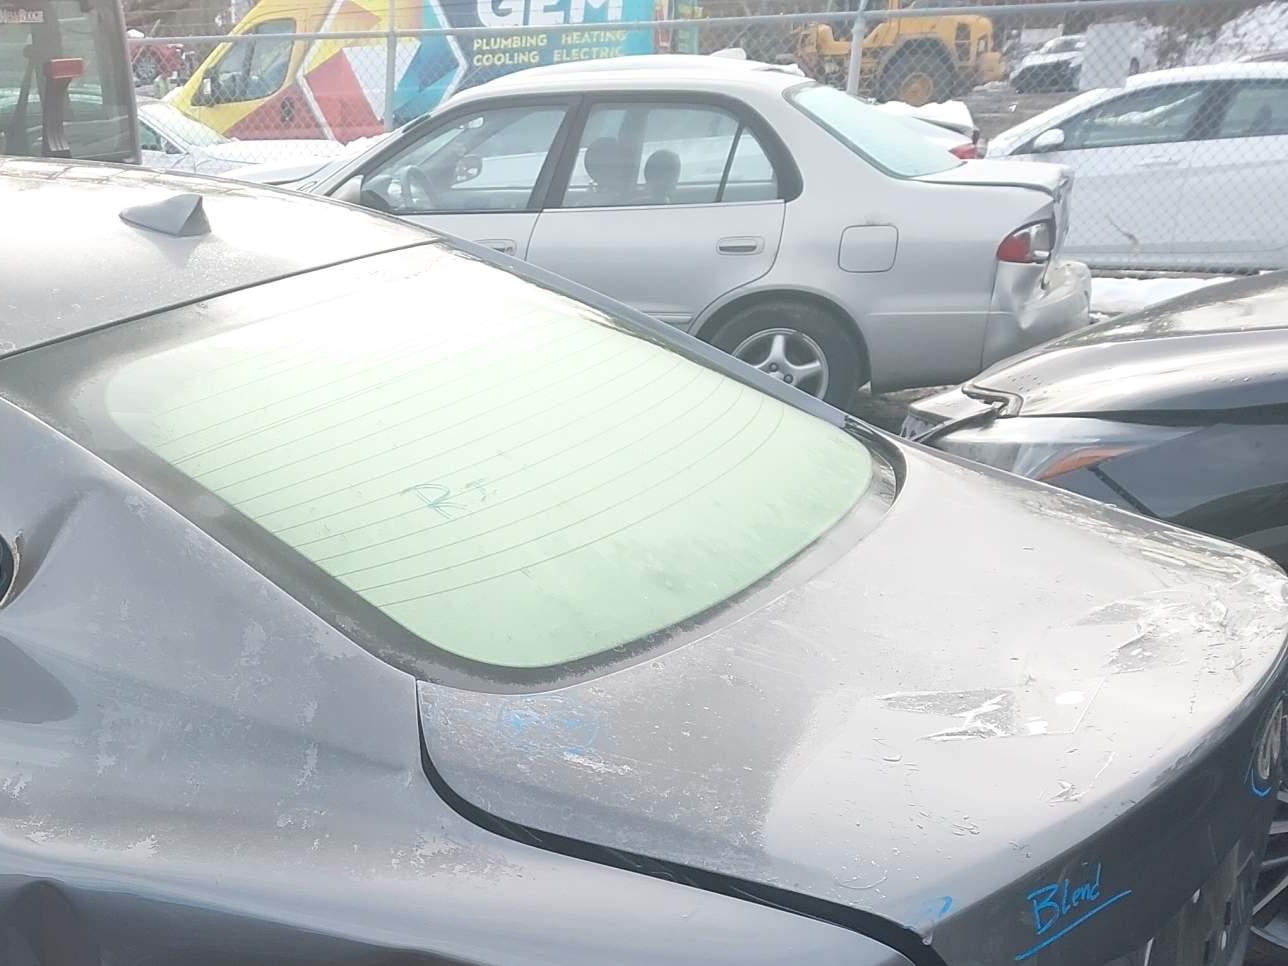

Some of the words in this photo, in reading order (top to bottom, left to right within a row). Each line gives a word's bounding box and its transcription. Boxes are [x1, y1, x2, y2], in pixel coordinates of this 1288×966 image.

[477, 0, 623, 27] GEM
[473, 34, 548, 50] PLUMBING
[561, 31, 627, 44] HEATING
[473, 51, 540, 66] COOLING
[553, 47, 625, 62] ELECTRIC
